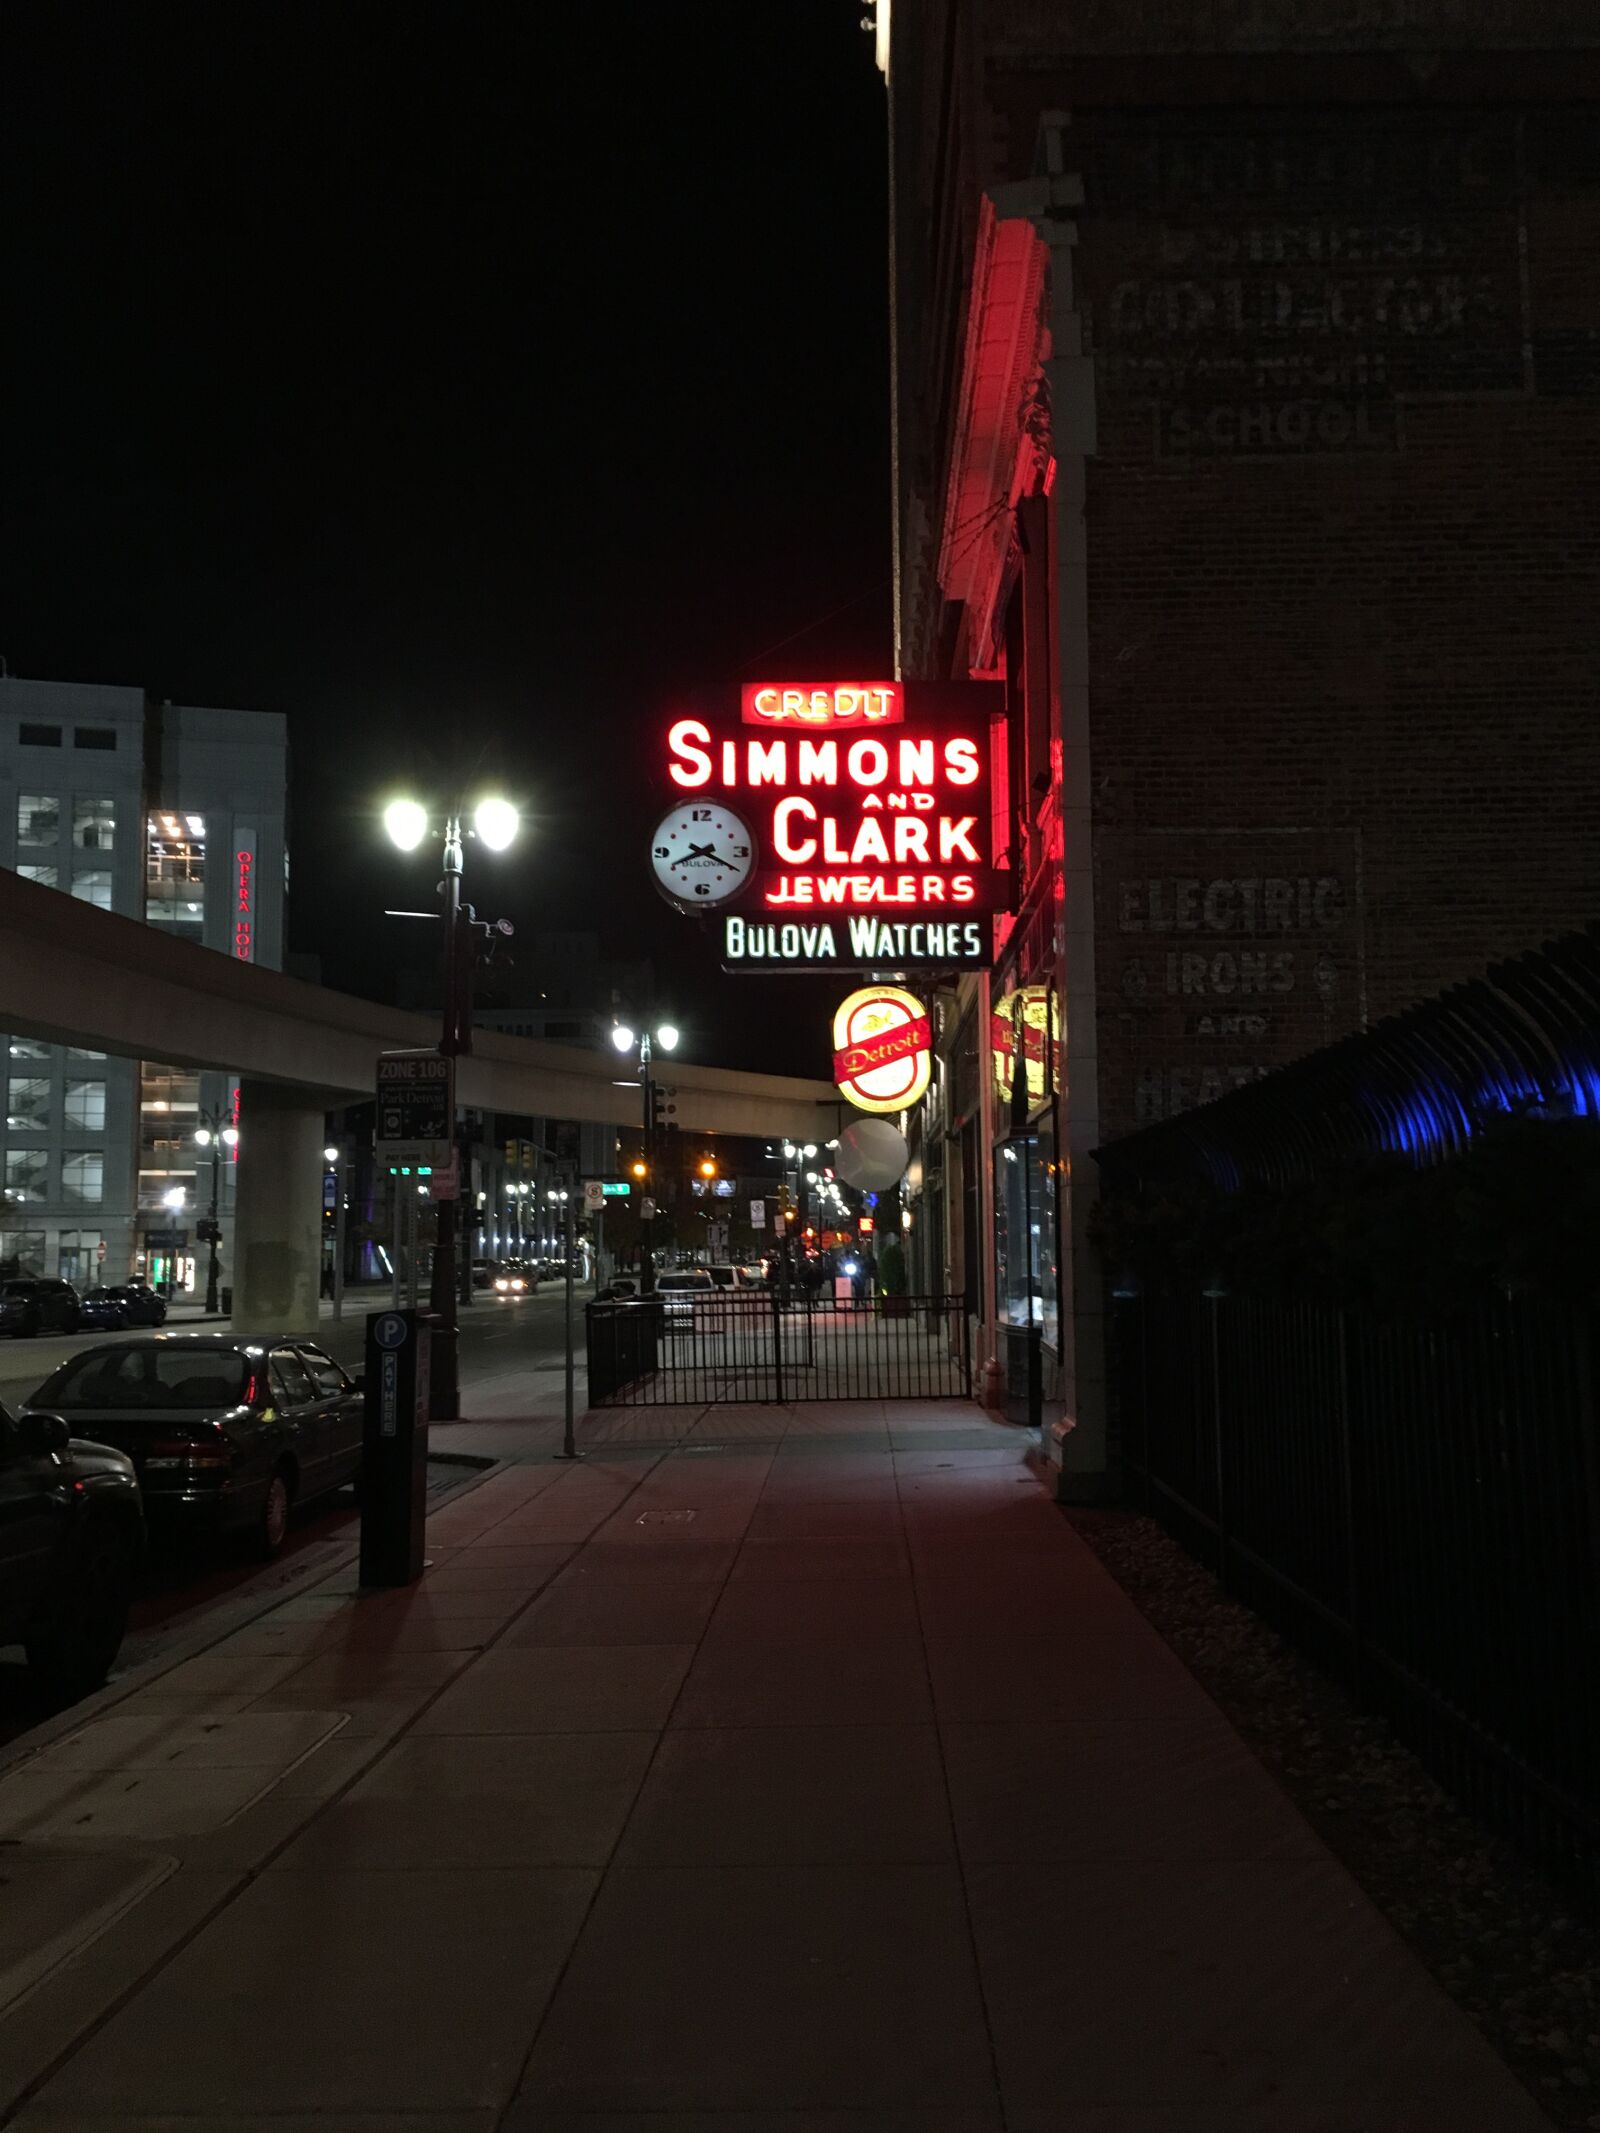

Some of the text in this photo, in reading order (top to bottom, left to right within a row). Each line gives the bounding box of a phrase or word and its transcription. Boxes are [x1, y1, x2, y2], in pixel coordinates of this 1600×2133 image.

[1169, 403, 1388, 448] SCHOOL
[754, 689, 894, 719] CREDIT
[668, 719, 980, 787] SIMMONS
[692, 809, 713, 822] 12
[862, 793, 935, 810] AND
[773, 796, 981, 864] CLARK
[654, 846, 670, 858] 9
[681, 860, 725, 868] BULOVA
[733, 845, 749, 858] 3
[236, 851, 253, 913] OPERA
[694, 883, 711, 896] 6
[765, 875, 975, 904] JEWELERS
[1118, 876, 1346, 933] ELECTRIC
[726, 915, 981, 959] BULOVA WATCHES
[1164, 950, 1296, 995] IRONS
[842, 1030, 921, 1073] Detroit
[379, 1060, 447, 1079] ZONE 106
[1134, 1064, 1270, 1120] HEA
[384, 1319, 399, 1343] P
[384, 1356, 394, 1388] PAY
[383, 1391, 394, 1433] HERE
